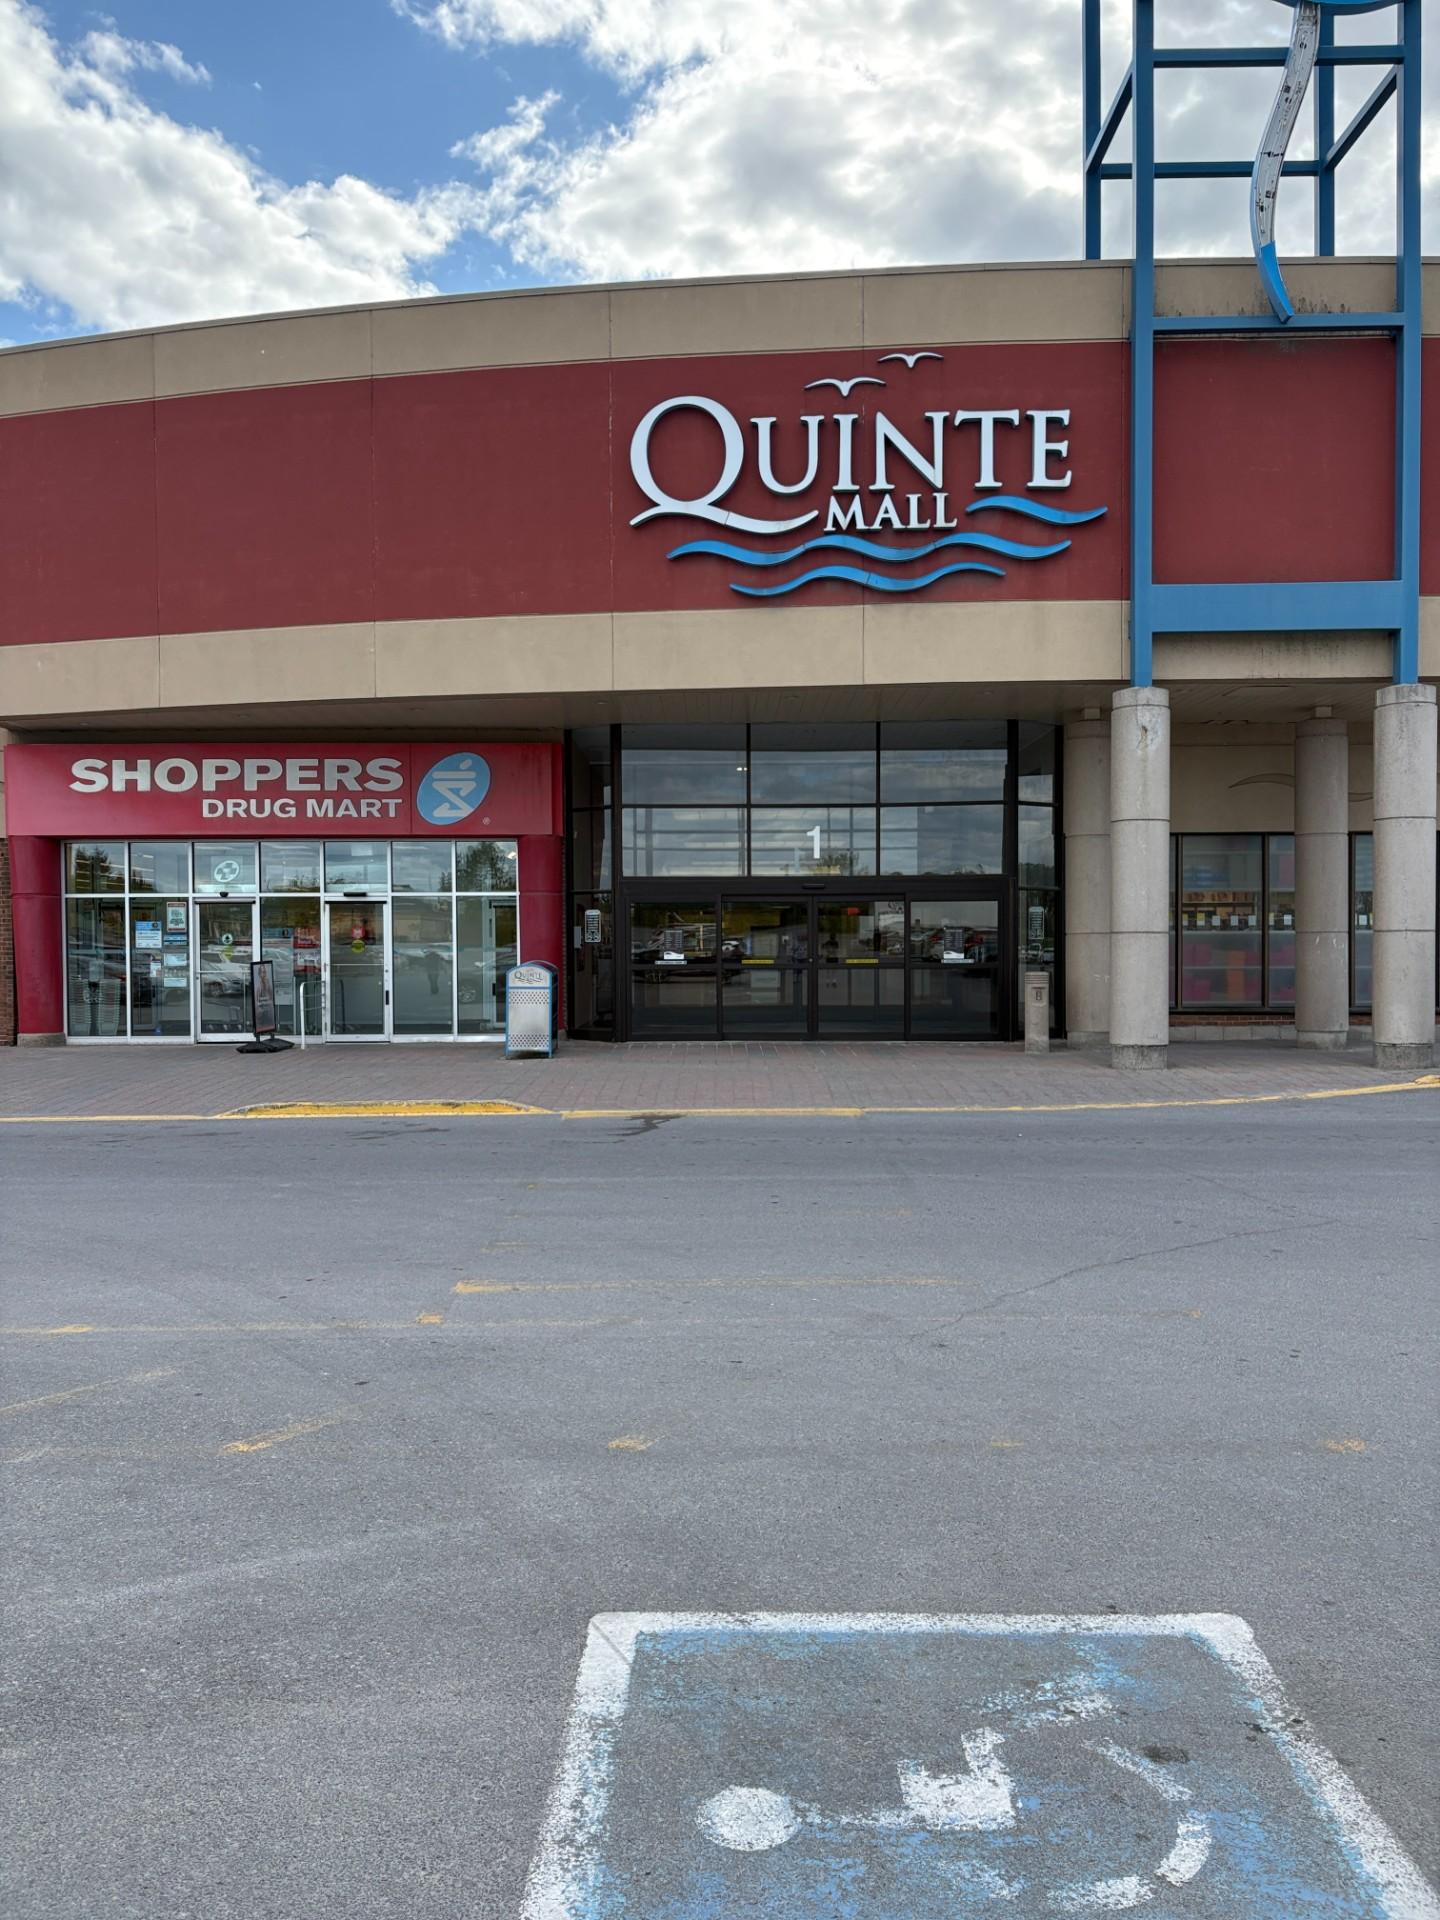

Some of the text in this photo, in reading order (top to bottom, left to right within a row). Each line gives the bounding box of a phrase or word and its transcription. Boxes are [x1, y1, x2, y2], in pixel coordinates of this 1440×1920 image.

[629, 394, 1073, 535] QUINTE
[823, 491, 958, 532] MALL
[68, 757, 404, 793] SHOPPERS
[202, 798, 403, 818] DRUG MART
[806, 825, 820, 859] 1
